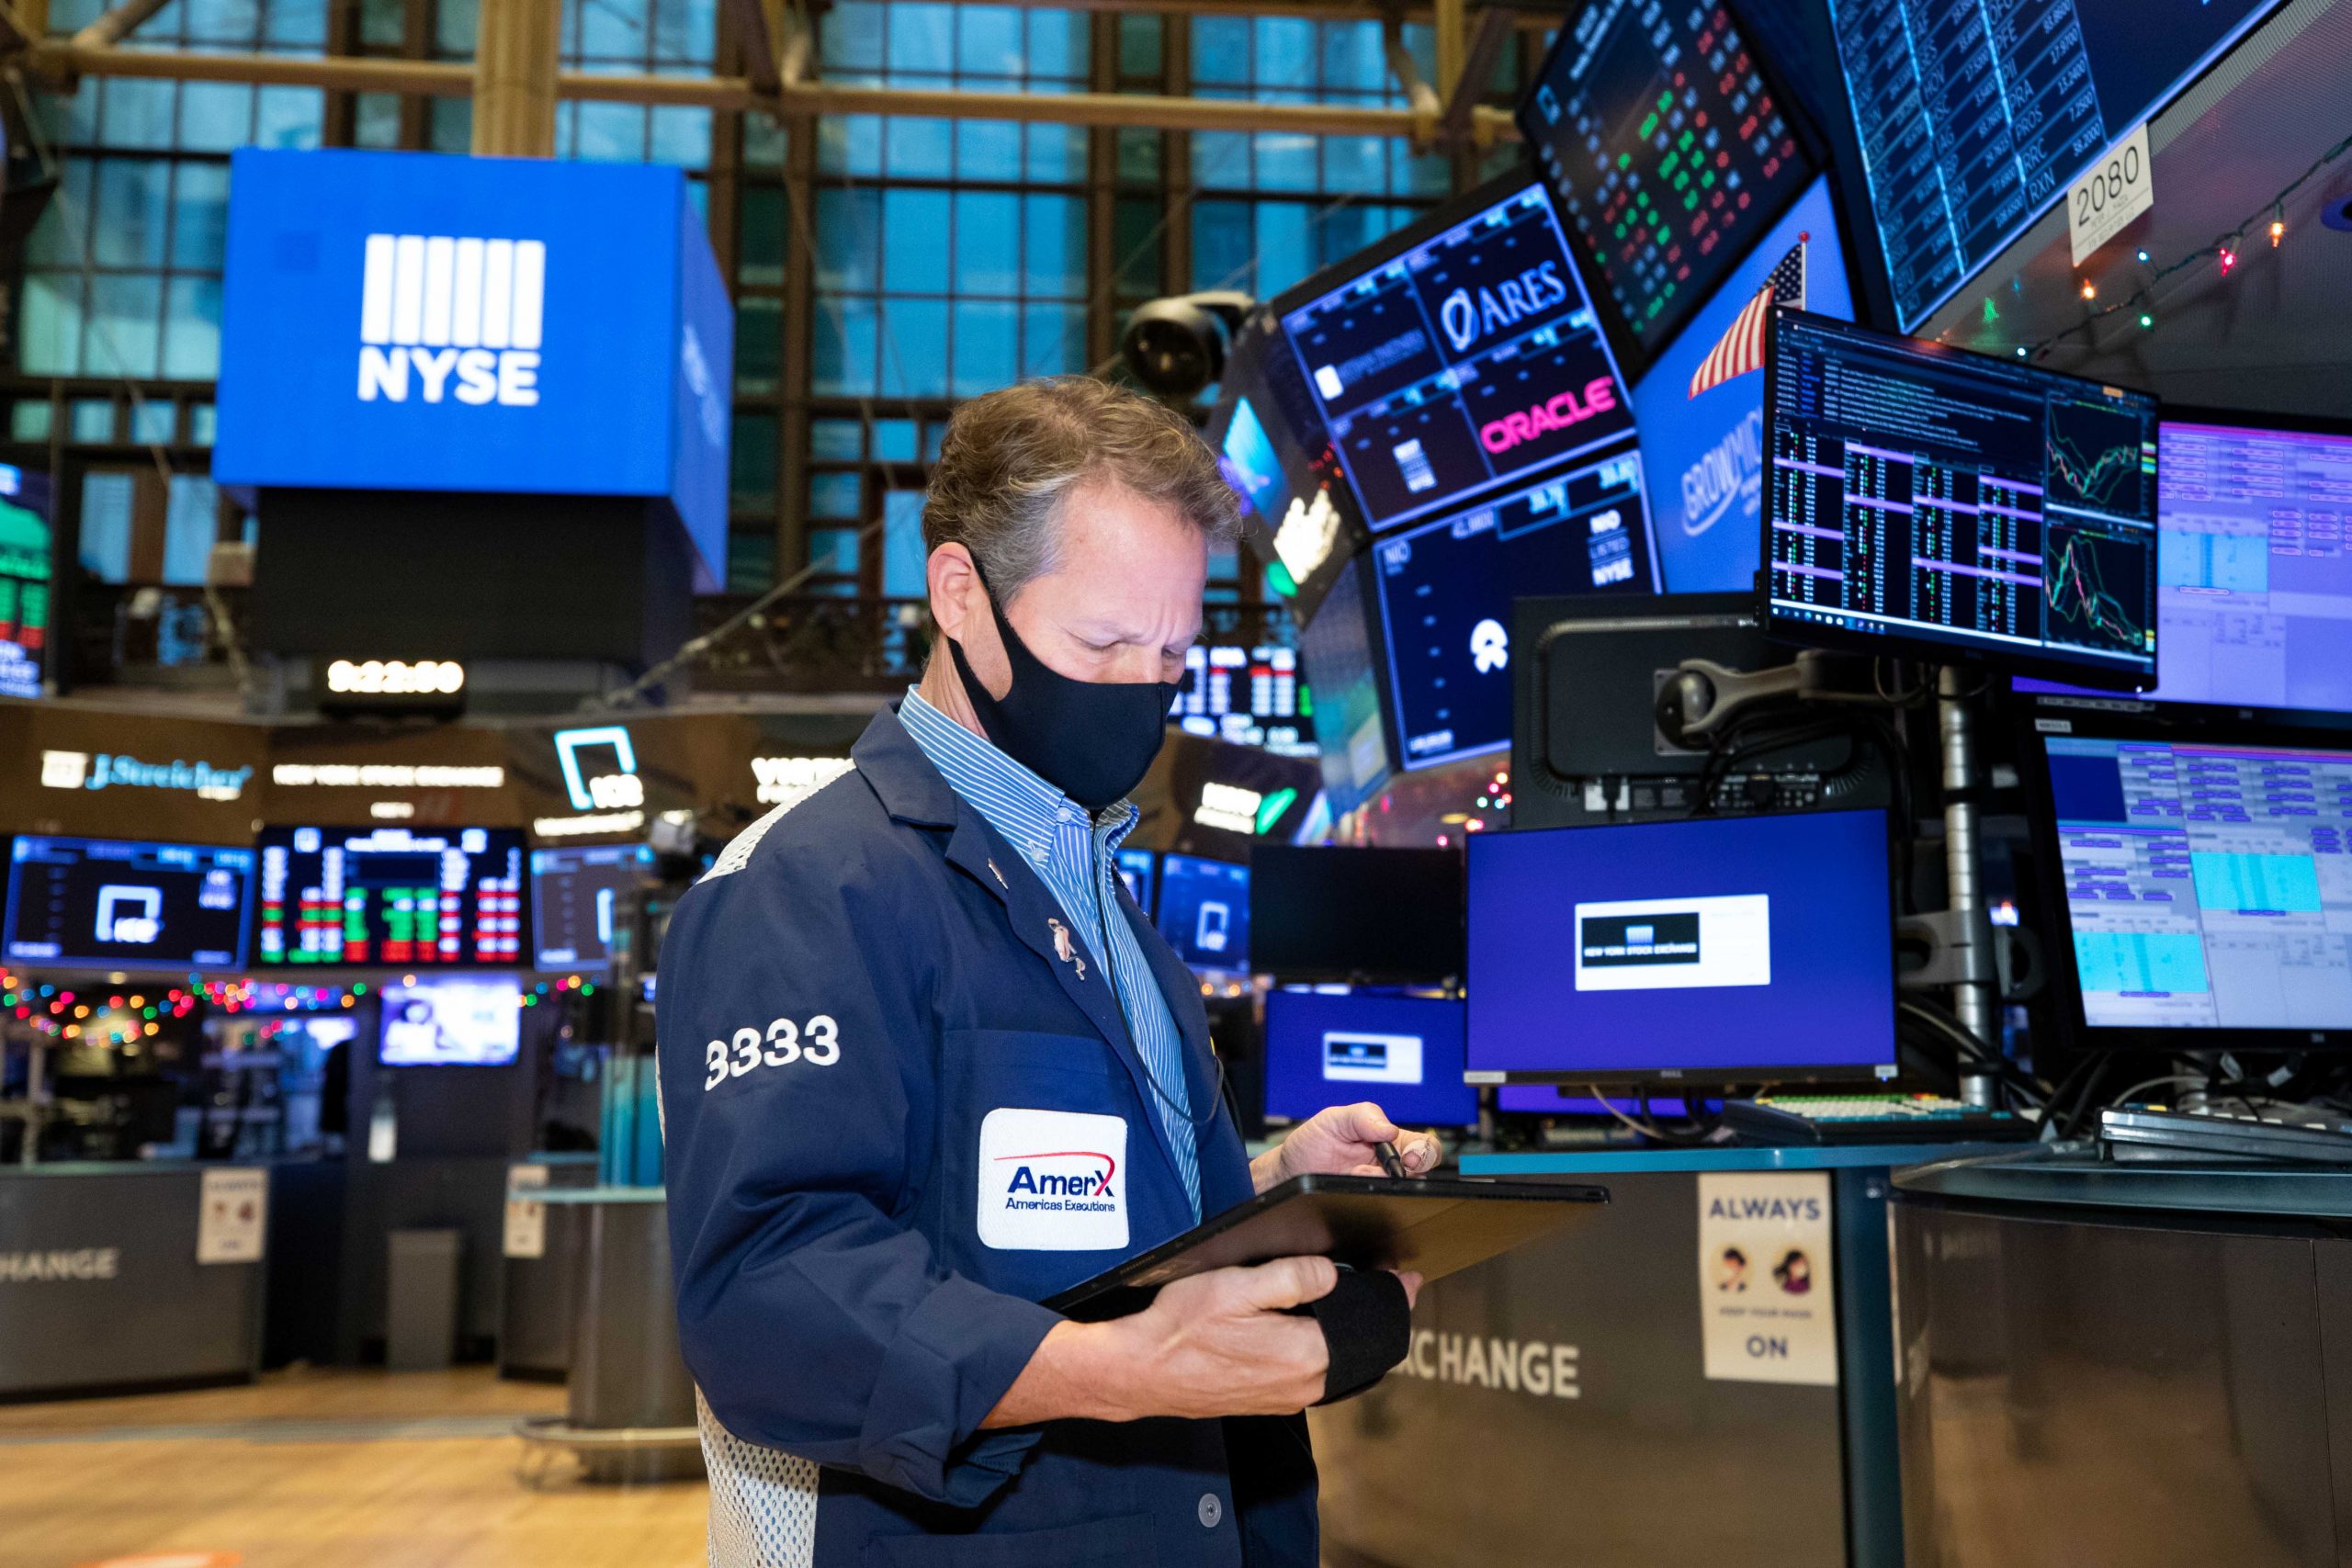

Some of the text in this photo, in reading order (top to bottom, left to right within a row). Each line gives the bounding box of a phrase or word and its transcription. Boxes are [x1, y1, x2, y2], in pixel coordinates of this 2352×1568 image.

[2008, 79, 2034, 113] PRA
[2015, 104, 2043, 141] PROS
[2022, 138, 2048, 174] RRC
[2029, 167, 2056, 204] RXN
[2077, 145, 2139, 227] 2080
[1478, 260, 1566, 334] ARES
[357, 344, 541, 406] NYSE
[1480, 376, 1615, 454] ORACLE
[1589, 509, 1622, 534] NIO
[1385, 540, 1411, 565] NIO
[1592, 557, 1634, 587] NYSE
[1584, 942, 1697, 956] NEW YORK STOCK EXCHANGE
[705, 1014, 841, 1091] 3333
[1007, 1159, 1115, 1197] AmerX
[1006, 1198, 1115, 1212] Americas Executions
[1710, 1199, 1821, 1220] ALWAYS
[1747, 1336, 1788, 1358] ON
